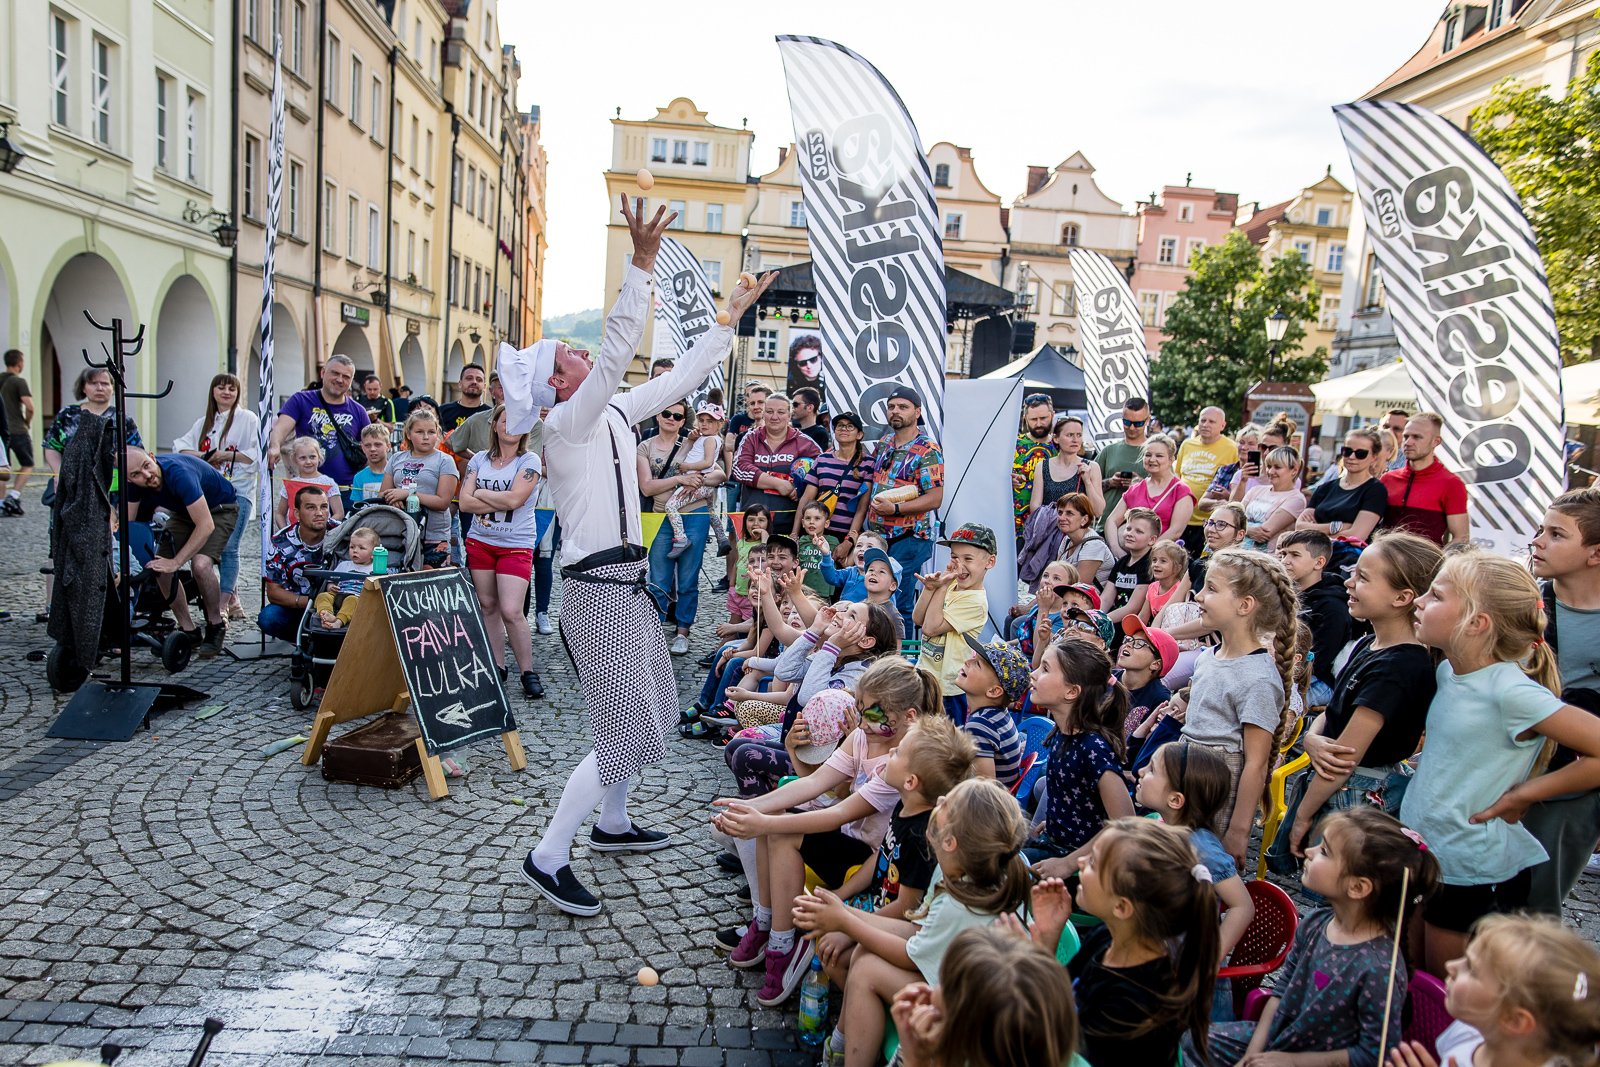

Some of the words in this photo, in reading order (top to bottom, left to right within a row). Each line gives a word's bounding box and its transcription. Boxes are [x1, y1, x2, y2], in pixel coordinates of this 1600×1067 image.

[475, 477, 512, 492] STAY
[390, 582, 472, 619] KUCHNIA
[401, 614, 474, 661] PANA
[415, 650, 495, 697] LULKA
